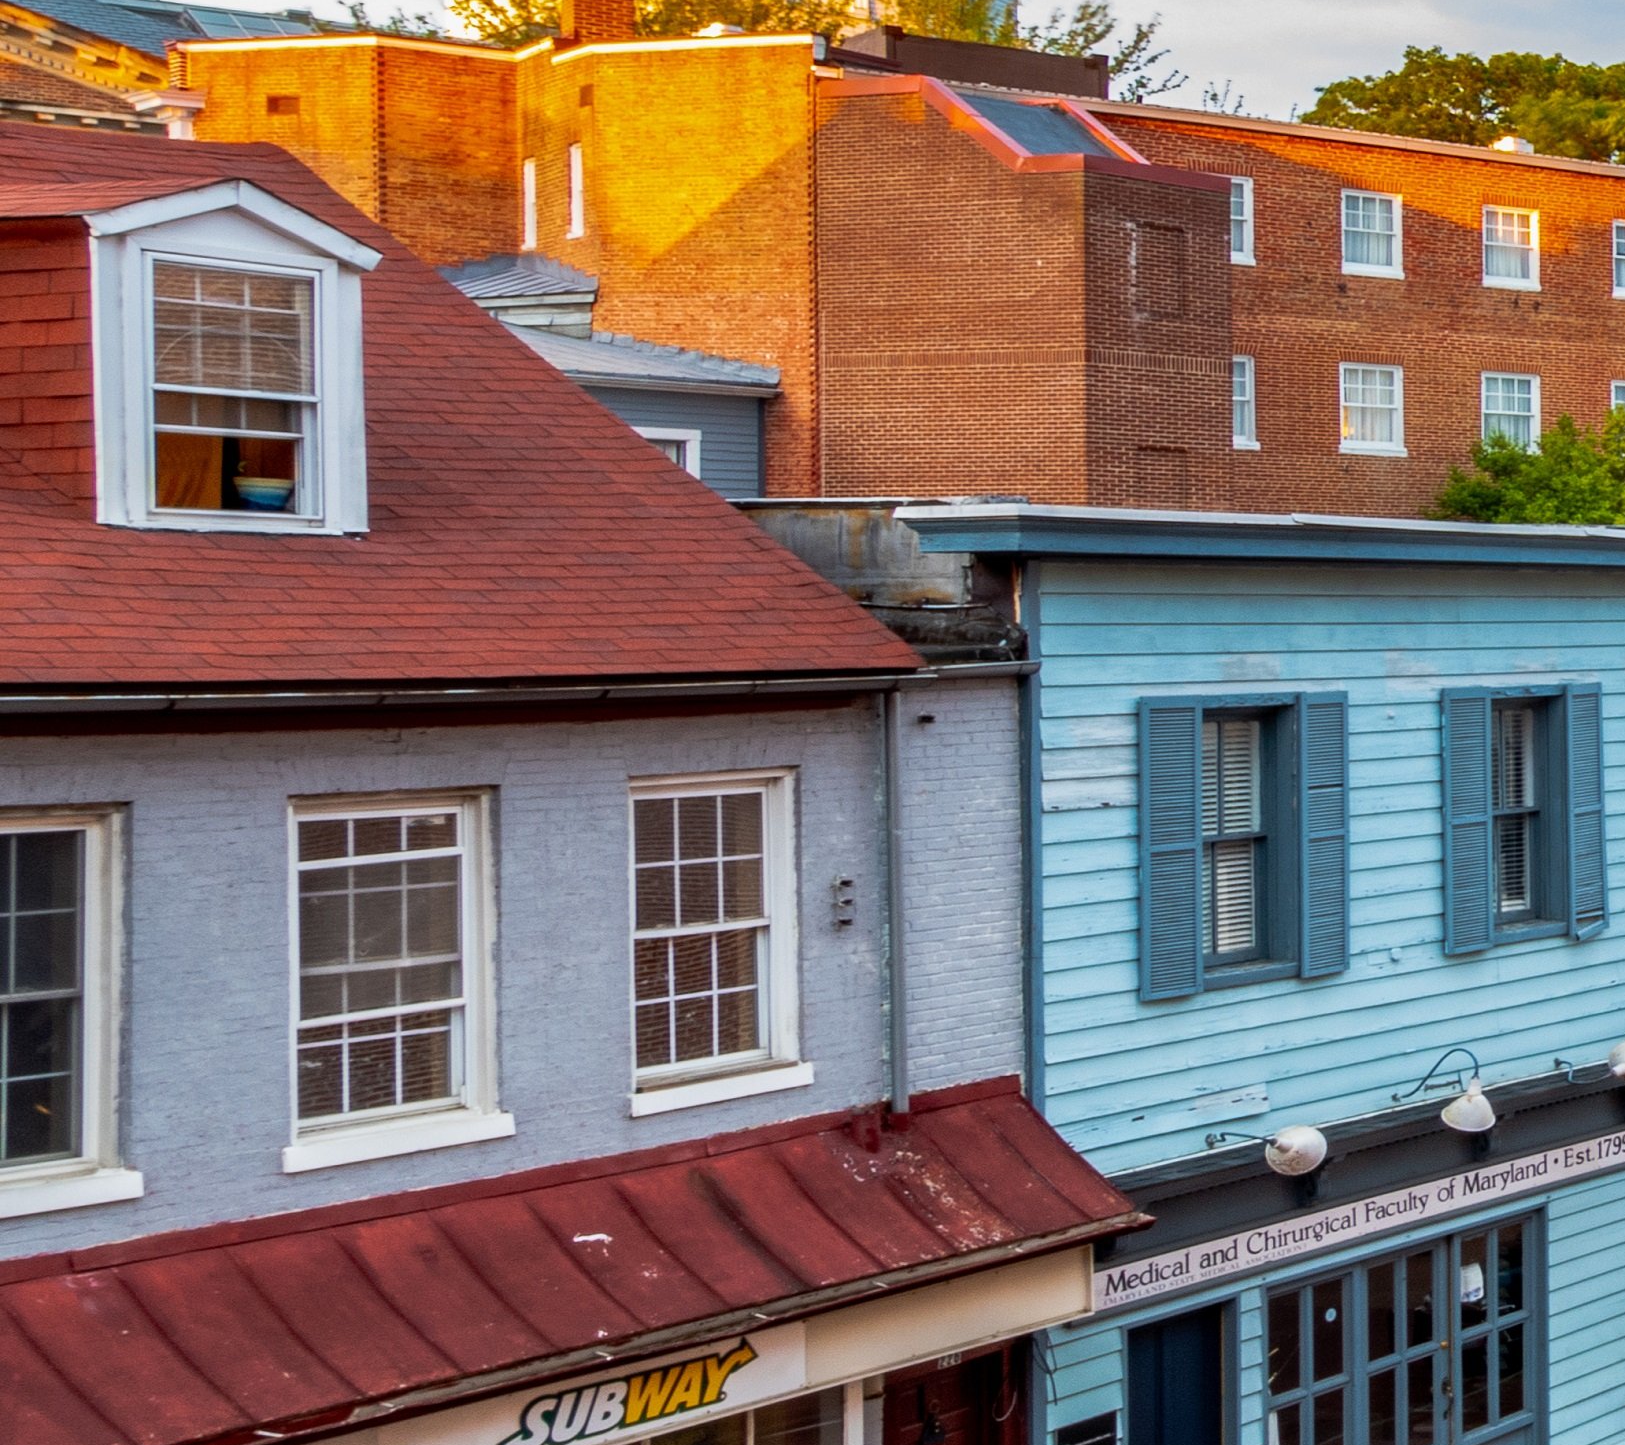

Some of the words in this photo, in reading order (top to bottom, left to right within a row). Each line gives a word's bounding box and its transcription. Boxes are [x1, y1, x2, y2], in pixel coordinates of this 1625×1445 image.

[1104, 1251, 1191, 1296] Medical
[1199, 1238, 1239, 1269] and
[1246, 1207, 1358, 1255] Chirurgical
[1364, 1191, 1430, 1223] Faculty
[1437, 1177, 1457, 1202] of
[1462, 1153, 1549, 1197] Maryland
